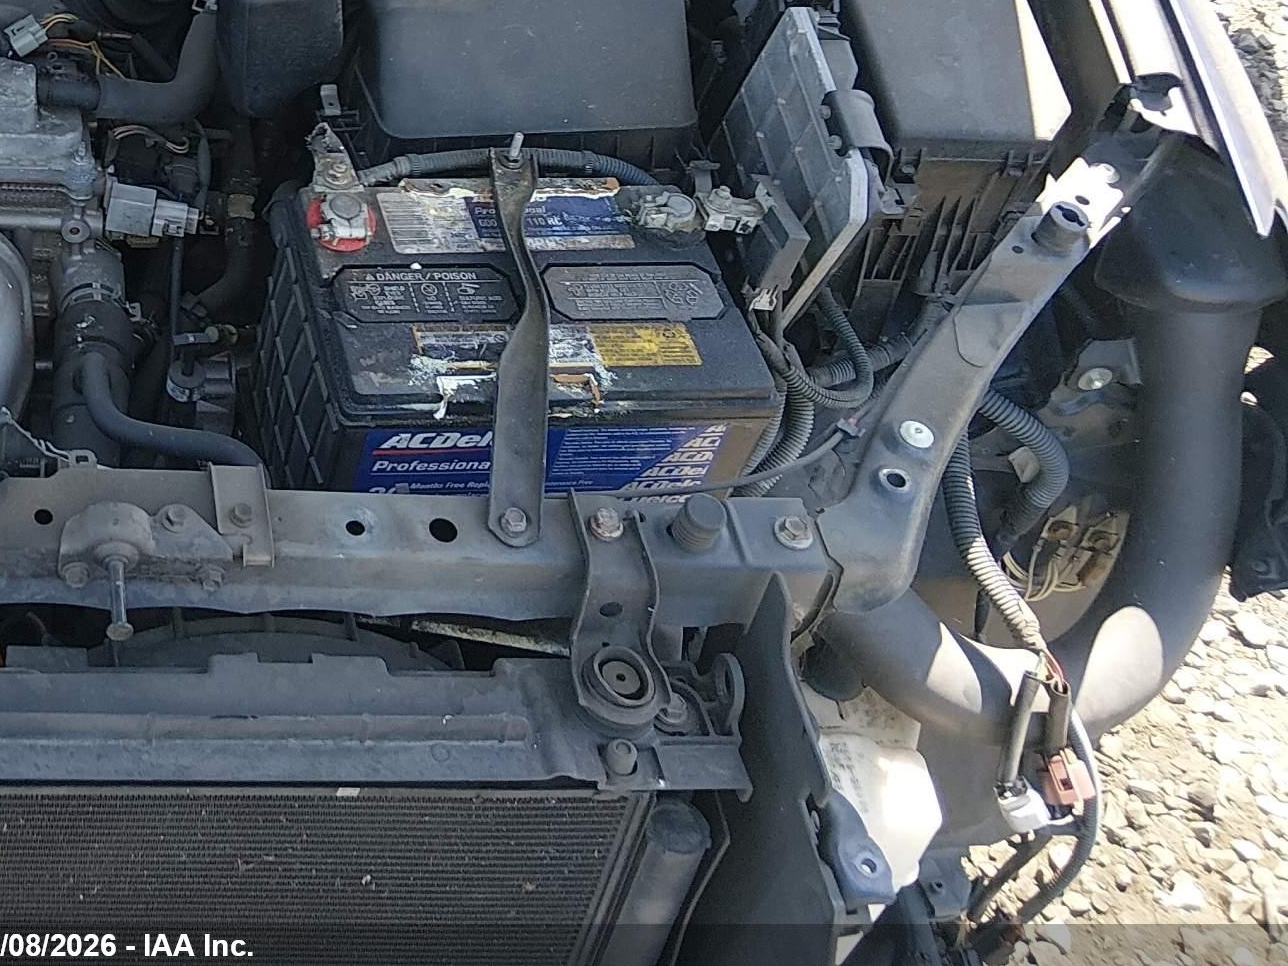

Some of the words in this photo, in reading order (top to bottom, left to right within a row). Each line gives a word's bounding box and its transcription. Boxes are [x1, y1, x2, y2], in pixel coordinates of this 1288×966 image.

[376, 272, 423, 281] DANGER
[432, 272, 477, 280] POISON
[379, 430, 493, 449] ACDel
[372, 459, 492, 472] Professiona
